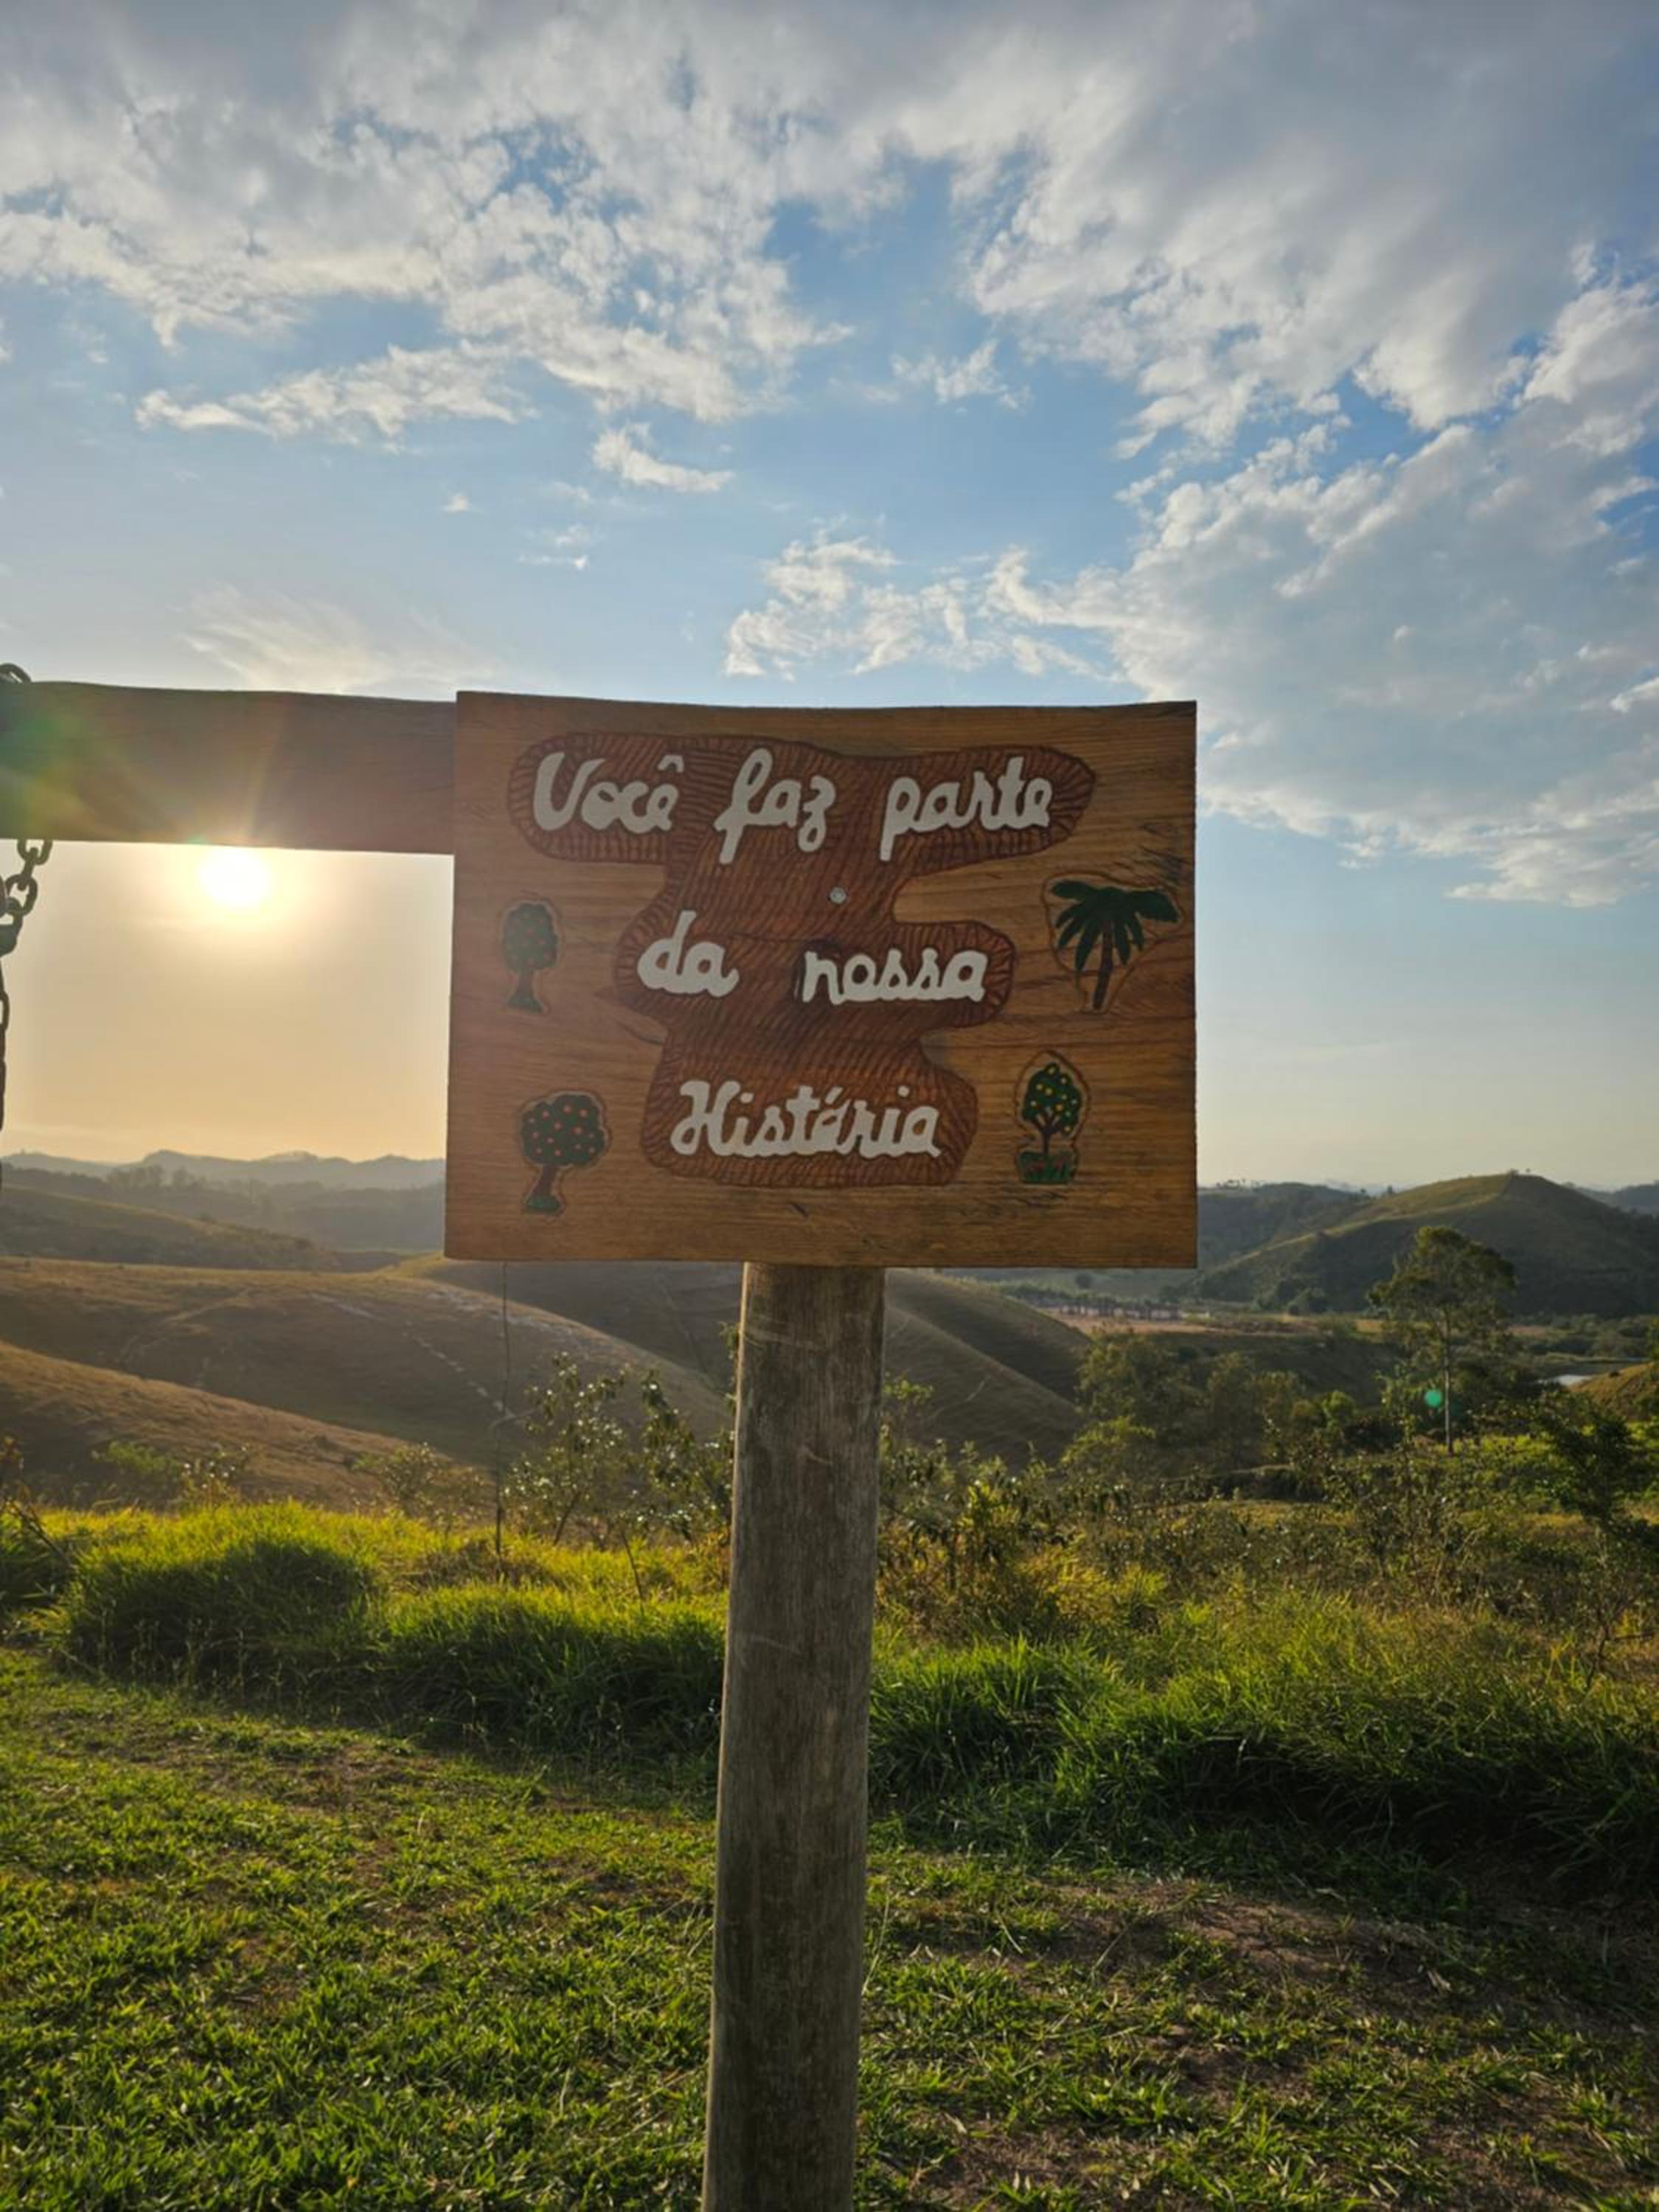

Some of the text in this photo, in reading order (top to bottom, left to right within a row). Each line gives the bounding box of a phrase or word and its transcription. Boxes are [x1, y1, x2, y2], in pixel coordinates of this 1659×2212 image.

[532, 748, 1054, 864] Você faz parte
[636, 910, 989, 1005] da nossa
